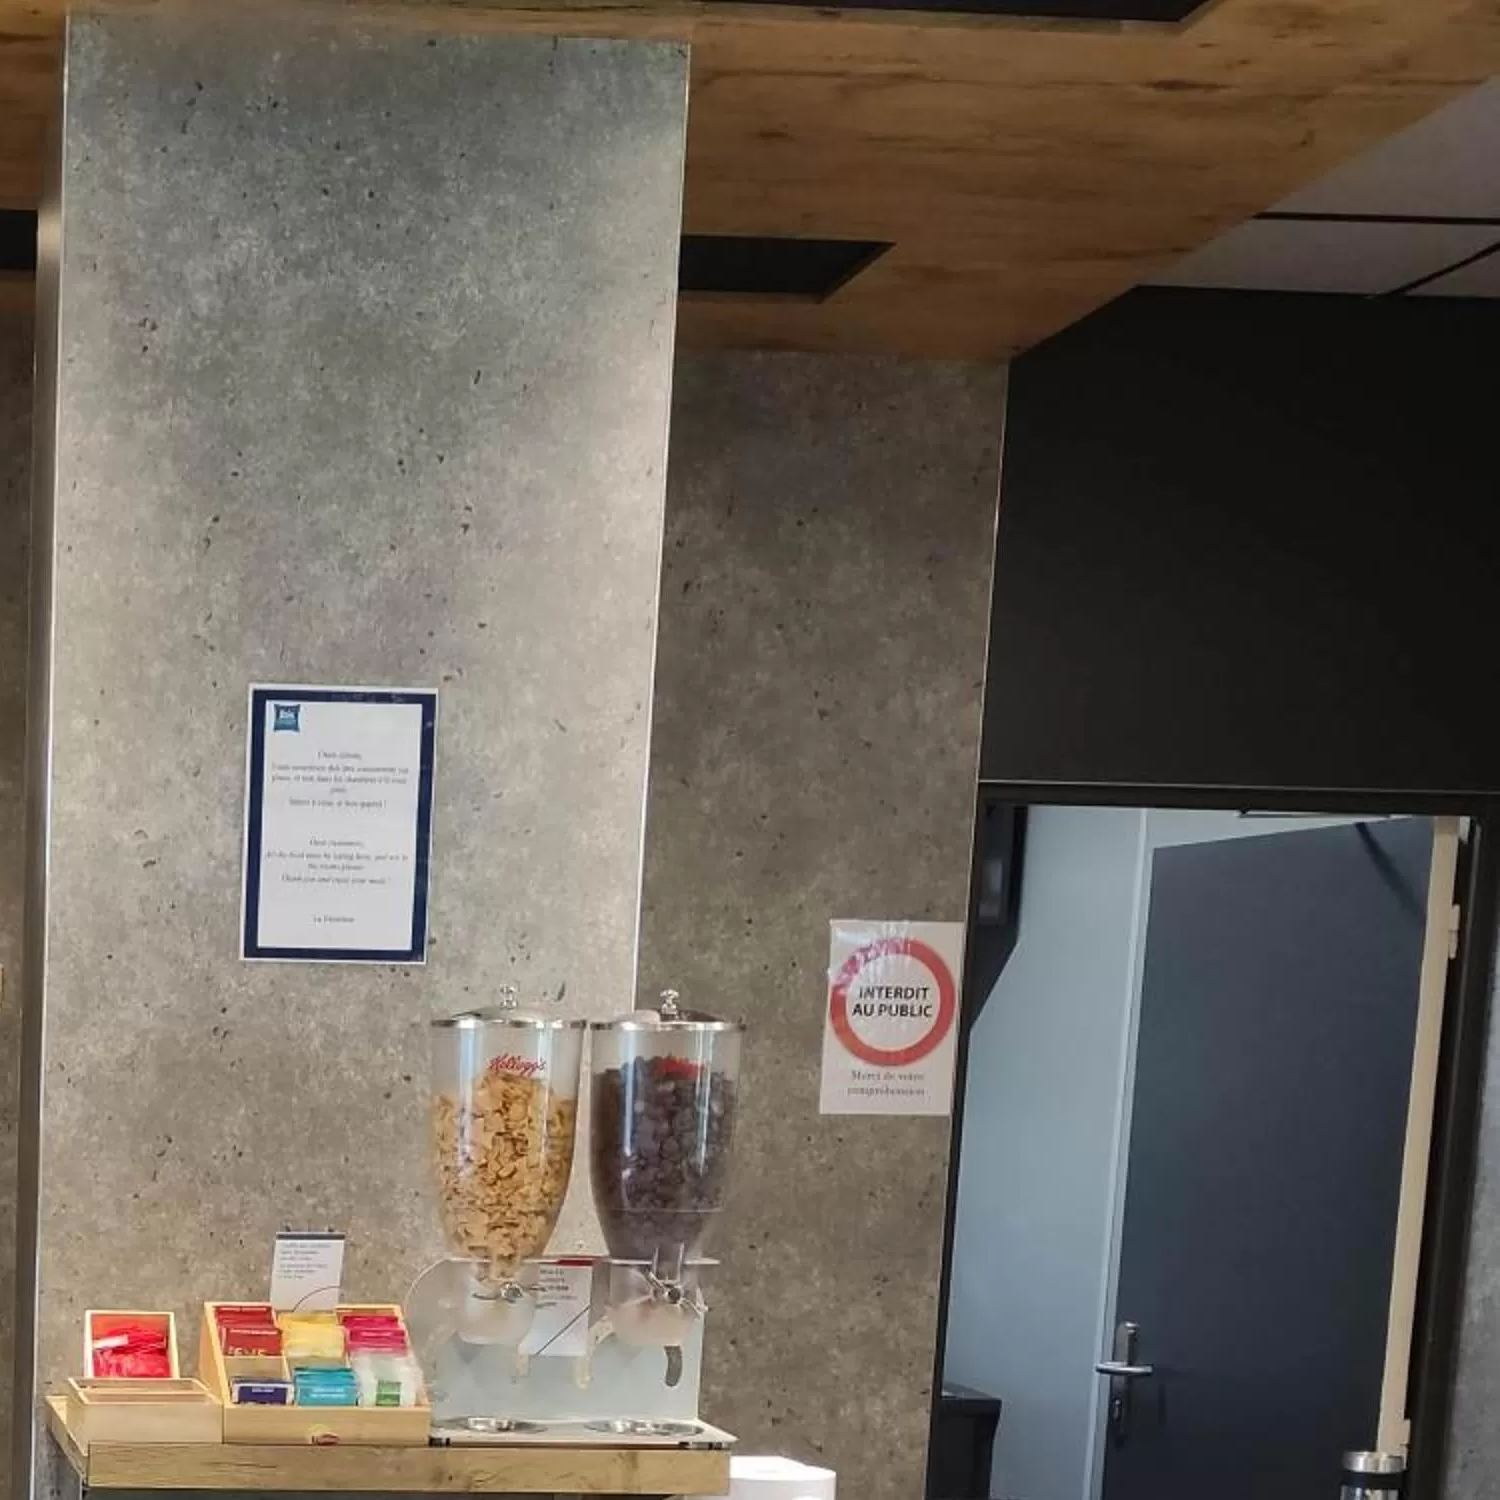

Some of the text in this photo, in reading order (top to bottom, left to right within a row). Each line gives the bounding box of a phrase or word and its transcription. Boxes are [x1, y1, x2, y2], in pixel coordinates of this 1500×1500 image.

[859, 986, 930, 1001] INTERDIT
[852, 1003, 933, 1018] AU PUBLIC
[488, 1053, 546, 1077] Kellogg's
